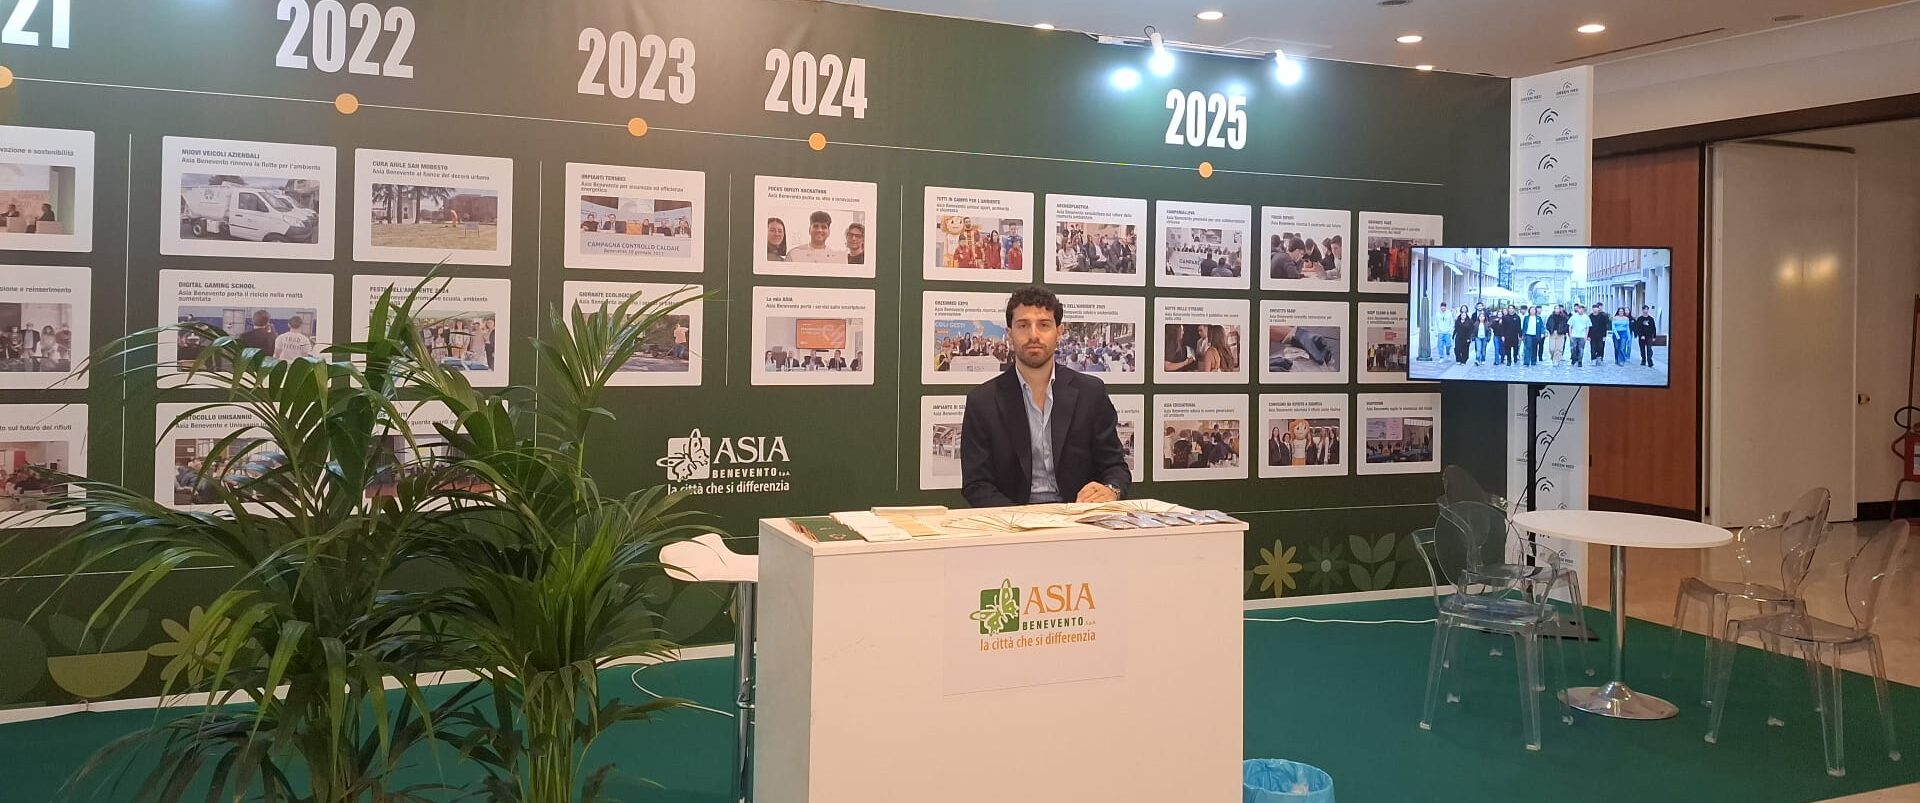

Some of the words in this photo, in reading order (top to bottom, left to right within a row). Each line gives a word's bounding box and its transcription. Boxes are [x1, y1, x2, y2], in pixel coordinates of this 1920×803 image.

[1, 0, 70, 48] 21
[276, 0, 416, 79] 2022
[578, 27, 696, 105] 2023
[764, 48, 868, 119] 2024
[1165, 88, 1247, 150] 2025
[622, 242, 655, 250] CONTROLLO
[713, 436, 790, 464] ASIA
[667, 483, 678, 496] la
[706, 482, 723, 494] che
[726, 481, 734, 494] si
[736, 479, 790, 493] differenzia
[712, 467, 777, 479] BENEVENTO
[1023, 583, 1096, 615] ASIA
[1022, 616, 1084, 631] BENEVENTO
[980, 638, 989, 652] la
[992, 637, 1014, 650] città
[1016, 635, 1034, 648] che
[1035, 634, 1043, 646] si
[1045, 630, 1096, 645] differenzia
